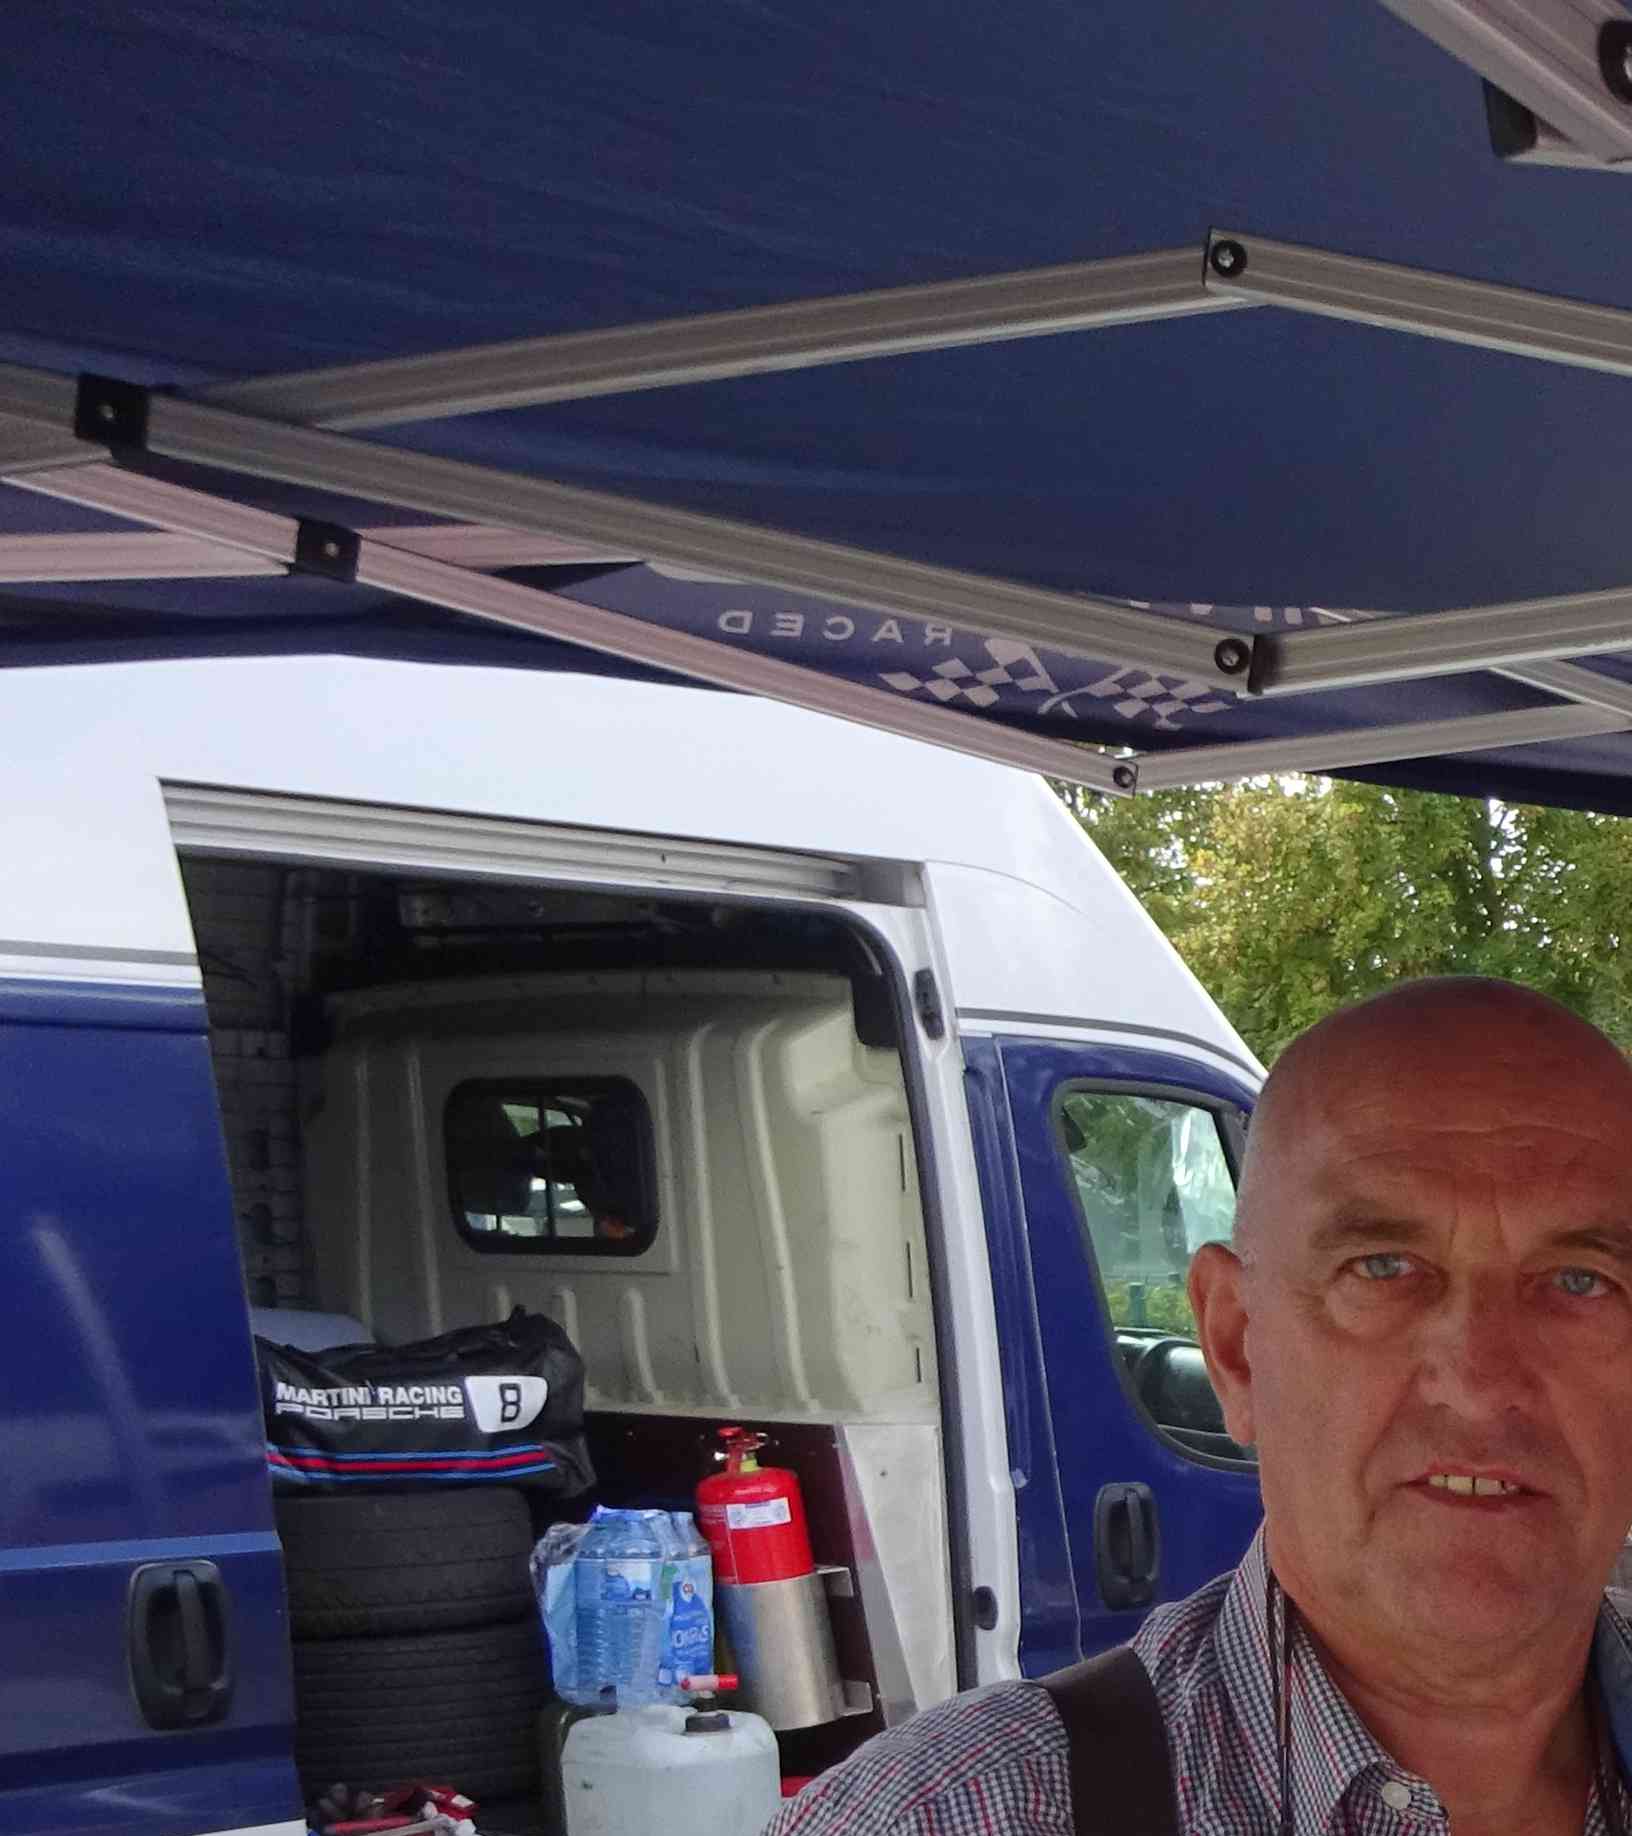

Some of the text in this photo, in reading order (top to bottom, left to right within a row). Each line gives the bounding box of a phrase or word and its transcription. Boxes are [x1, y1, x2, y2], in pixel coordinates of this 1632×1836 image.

[275, 1381, 464, 1406] MARTINI RACING
[275, 1402, 465, 1421] PORSCHE
